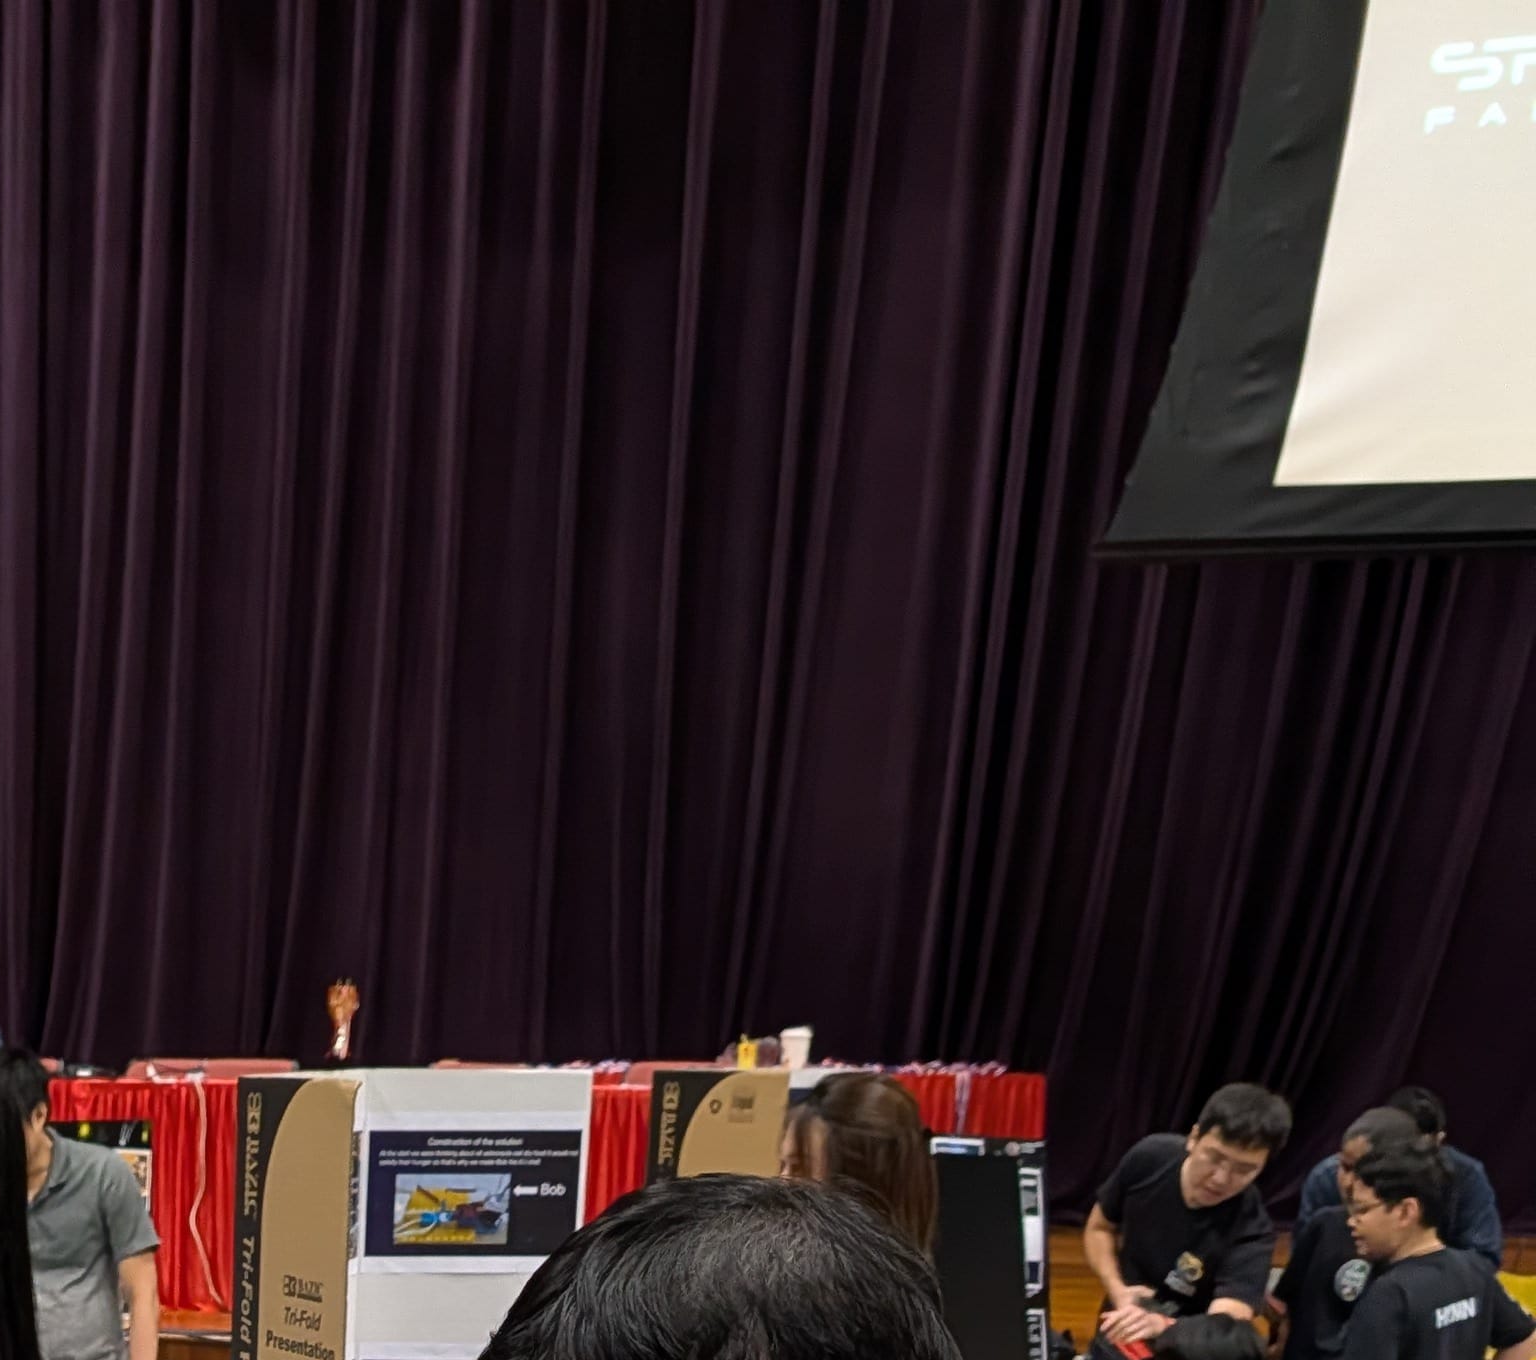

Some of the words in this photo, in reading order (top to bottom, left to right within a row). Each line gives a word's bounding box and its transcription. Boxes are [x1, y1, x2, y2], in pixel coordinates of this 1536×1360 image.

[540, 1182, 566, 1196] Bob
[240, 1236, 255, 1344] Tri-Fold
[284, 1307, 322, 1332] Tri-Fold
